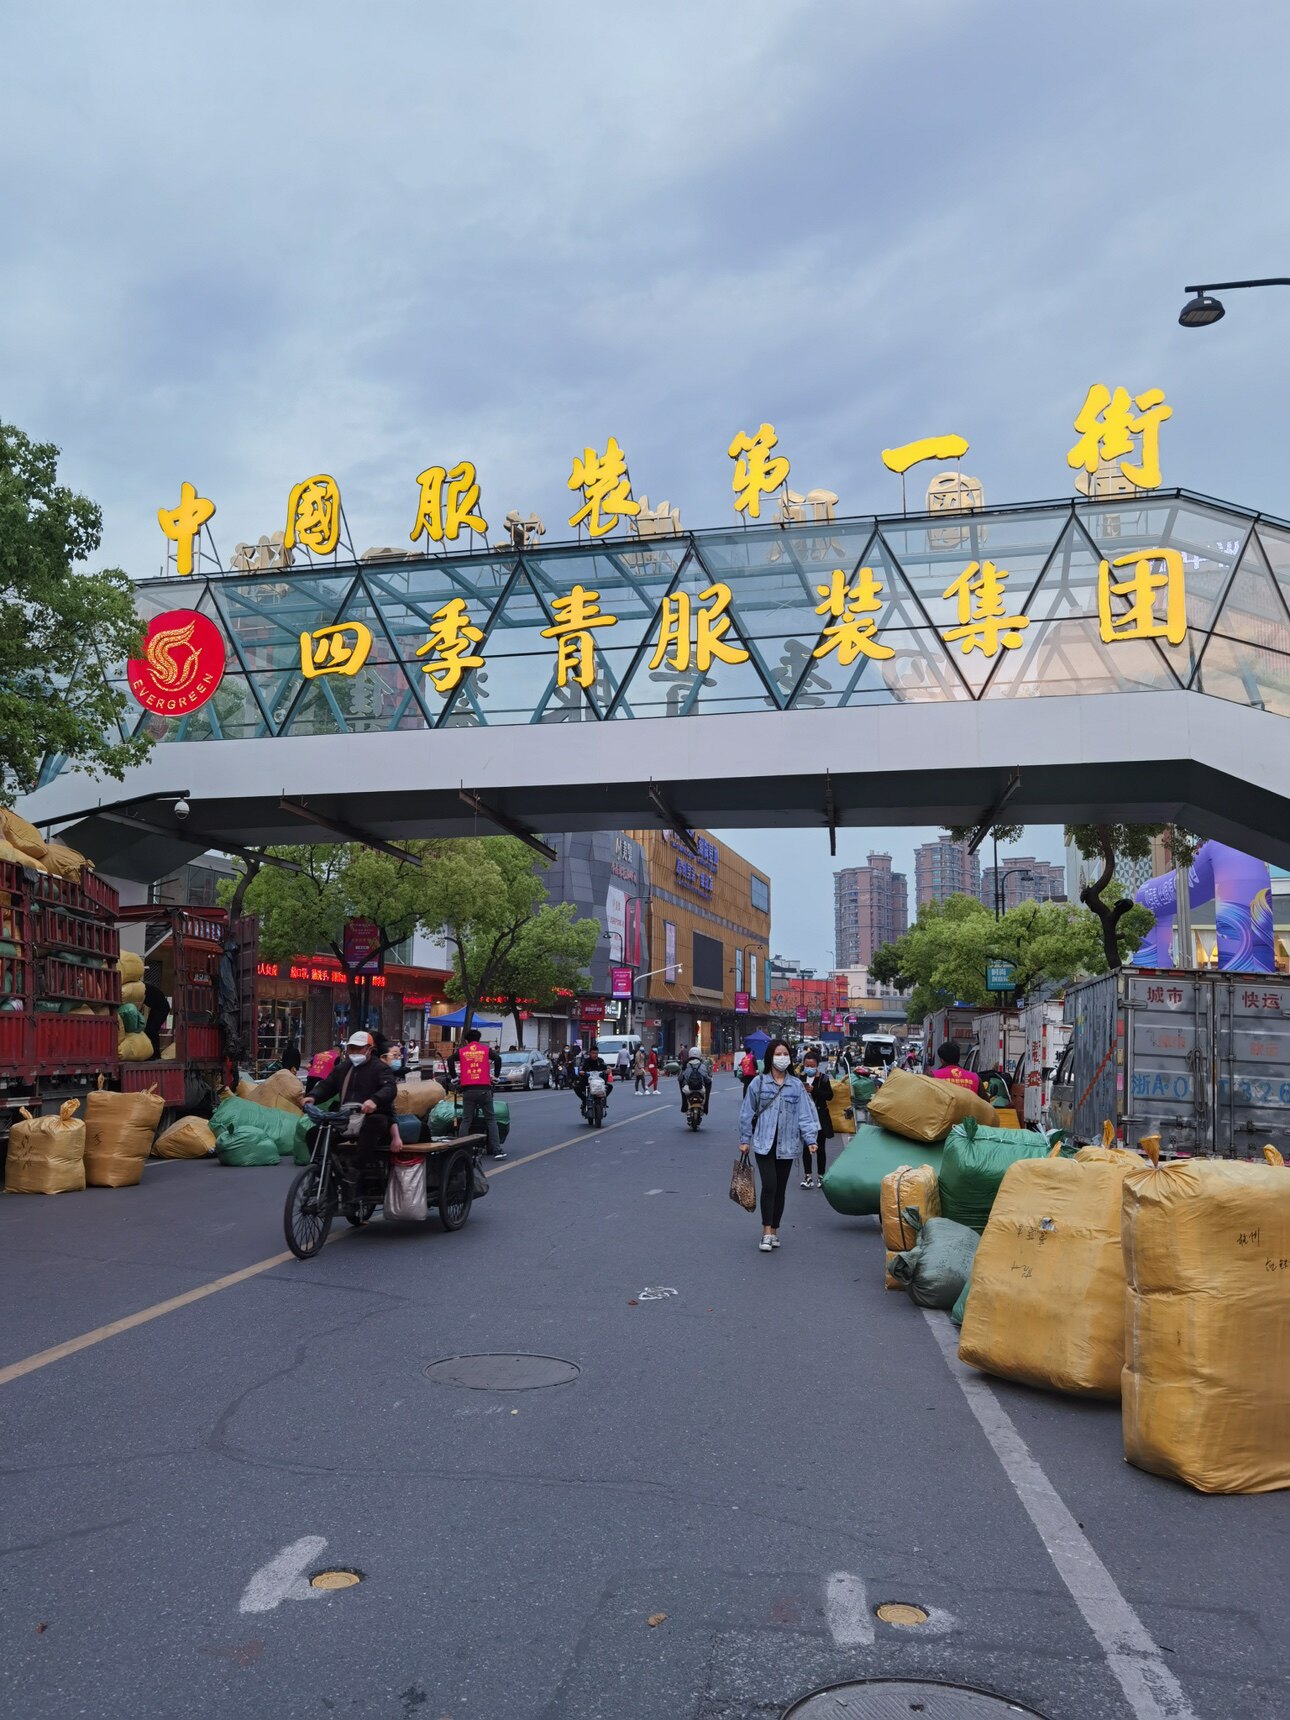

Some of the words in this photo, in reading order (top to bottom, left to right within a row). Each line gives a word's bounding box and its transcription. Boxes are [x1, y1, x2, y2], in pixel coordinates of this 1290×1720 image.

[299, 547, 1189, 693] 四季青服装集团
[133, 672, 214, 710] EVERGREEN
[1146, 986, 1184, 1005] 城市
[1242, 991, 1281, 1010] 快运
